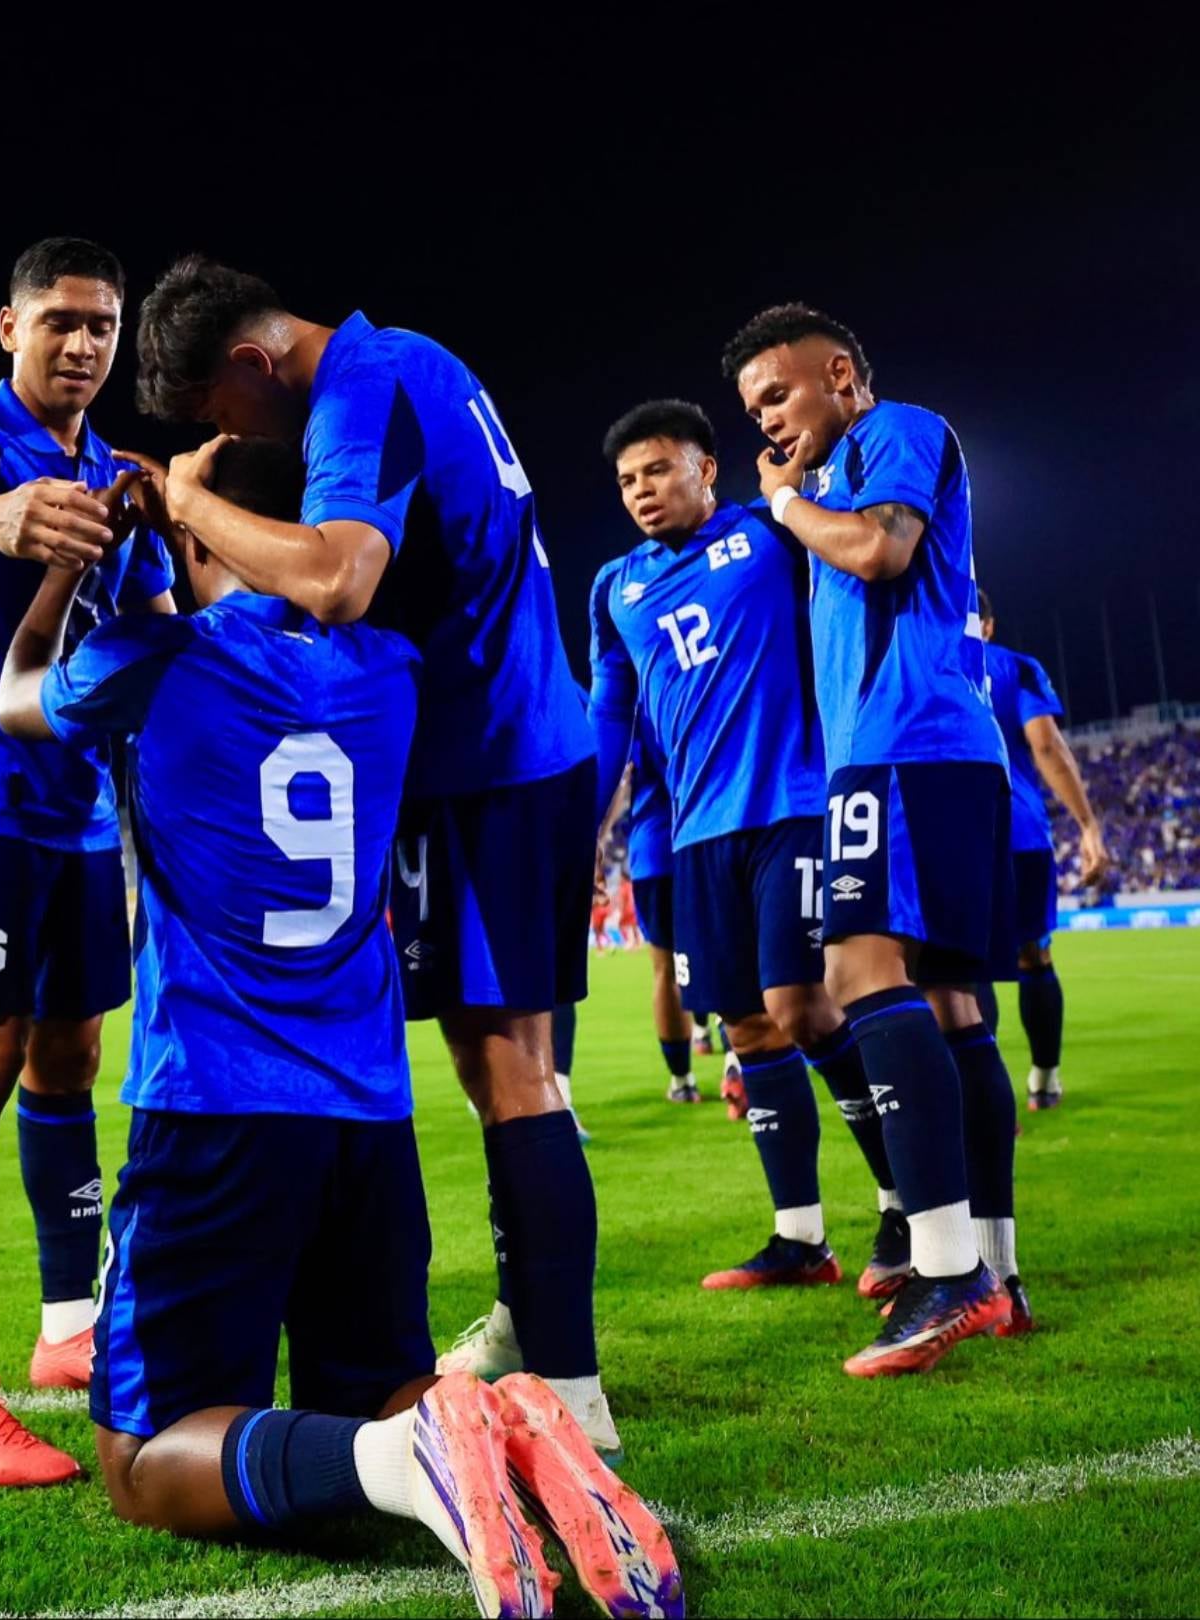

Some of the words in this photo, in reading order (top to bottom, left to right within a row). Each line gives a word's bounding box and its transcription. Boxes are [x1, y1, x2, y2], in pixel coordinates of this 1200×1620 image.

[706, 532, 752, 572] ES
[657, 602, 719, 672] 12
[259, 732, 354, 948] 9
[828, 791, 880, 862] 19
[397, 834, 429, 922] 4
[832, 892, 862, 902] umbro
